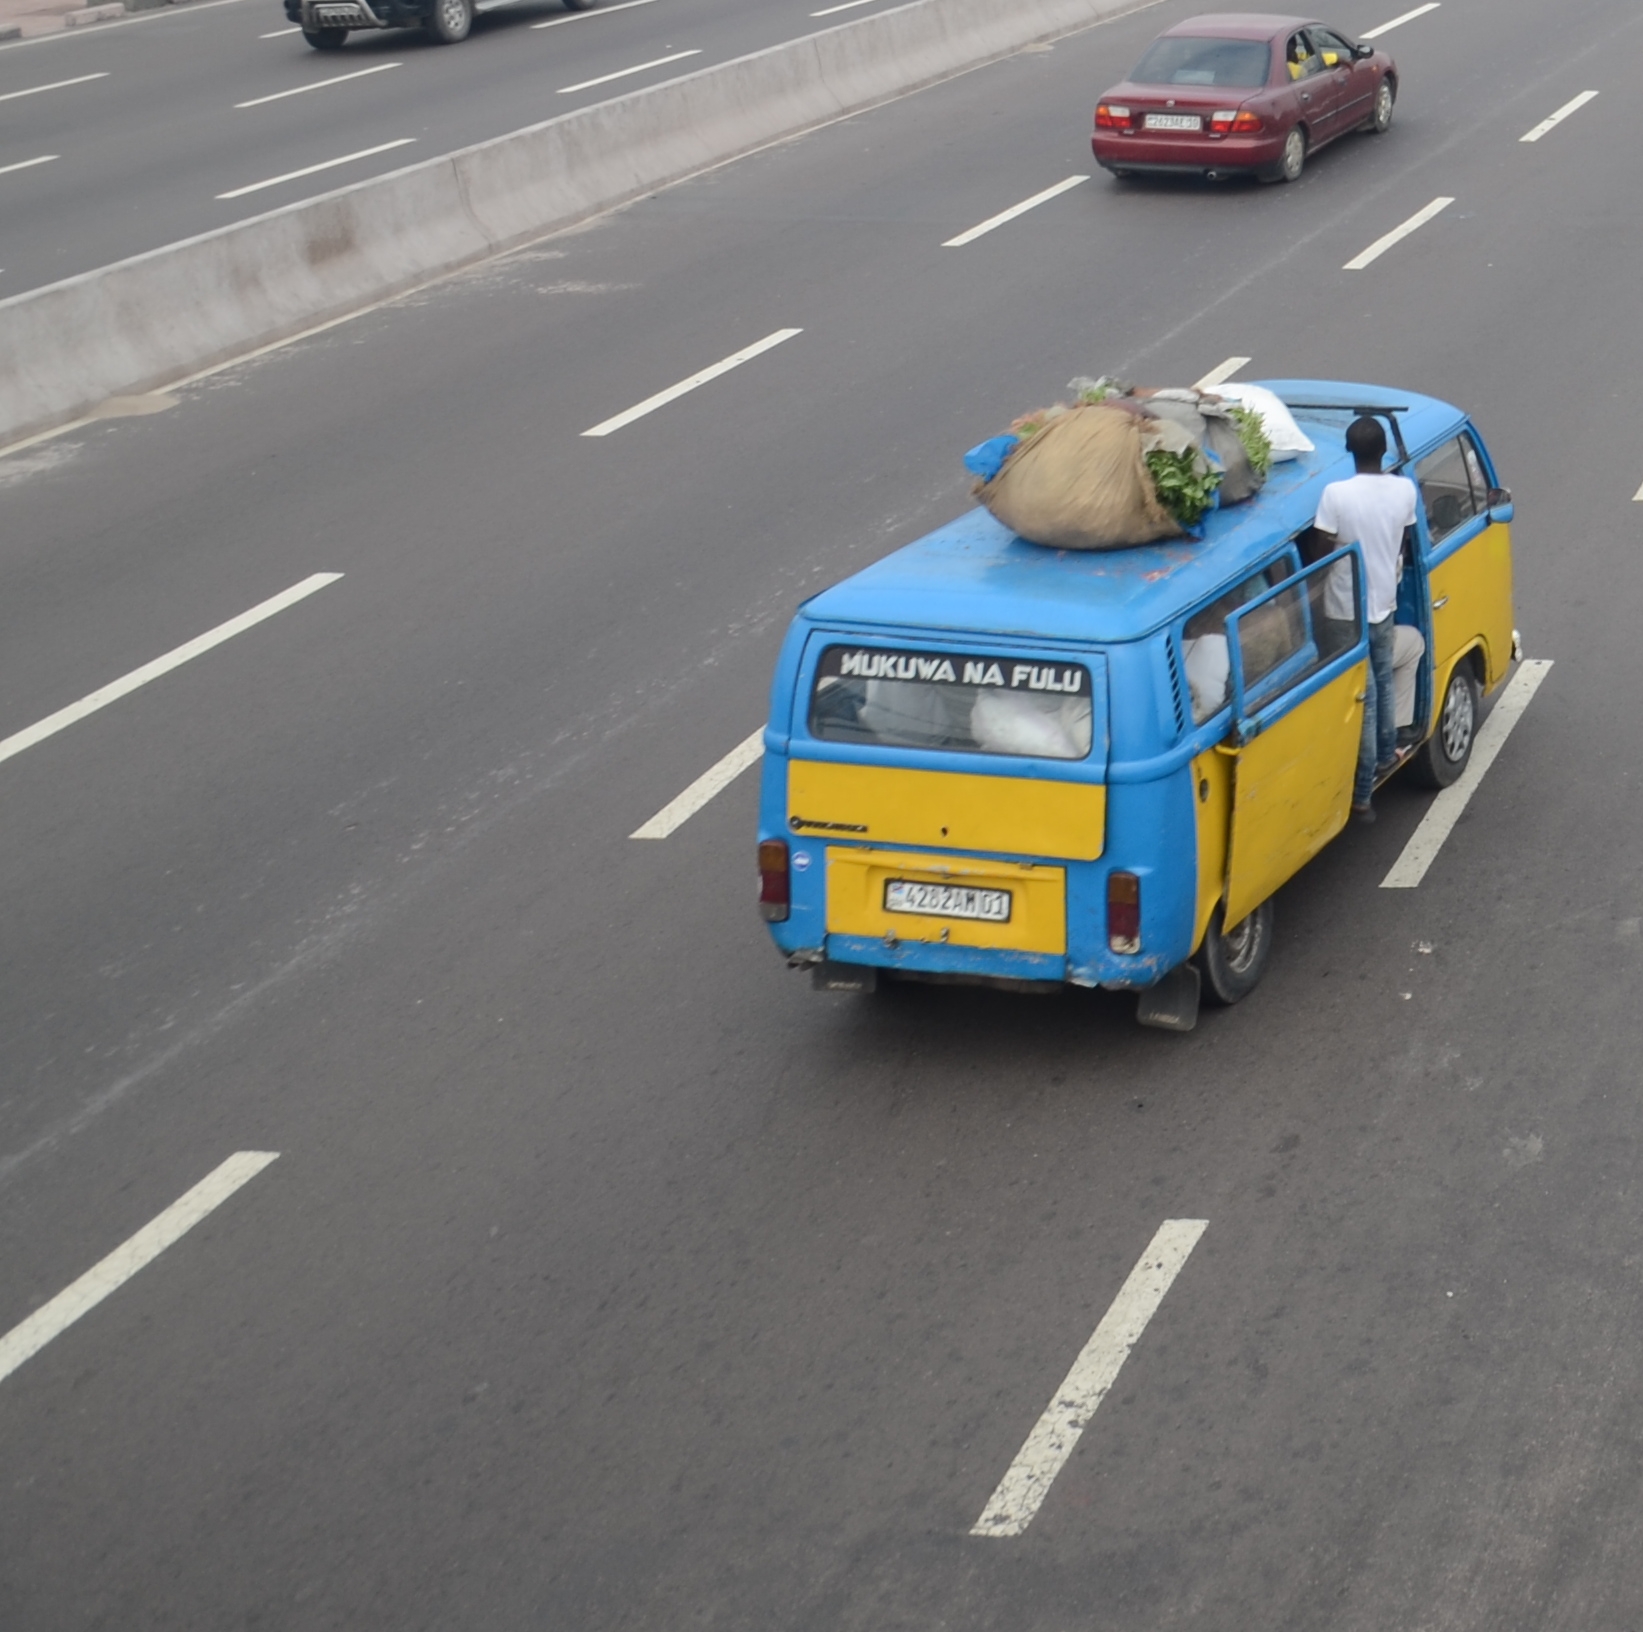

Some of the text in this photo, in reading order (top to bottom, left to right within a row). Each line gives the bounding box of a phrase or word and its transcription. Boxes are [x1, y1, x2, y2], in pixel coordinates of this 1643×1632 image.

[840, 650, 1082, 693] MUKUWA NA FULU
